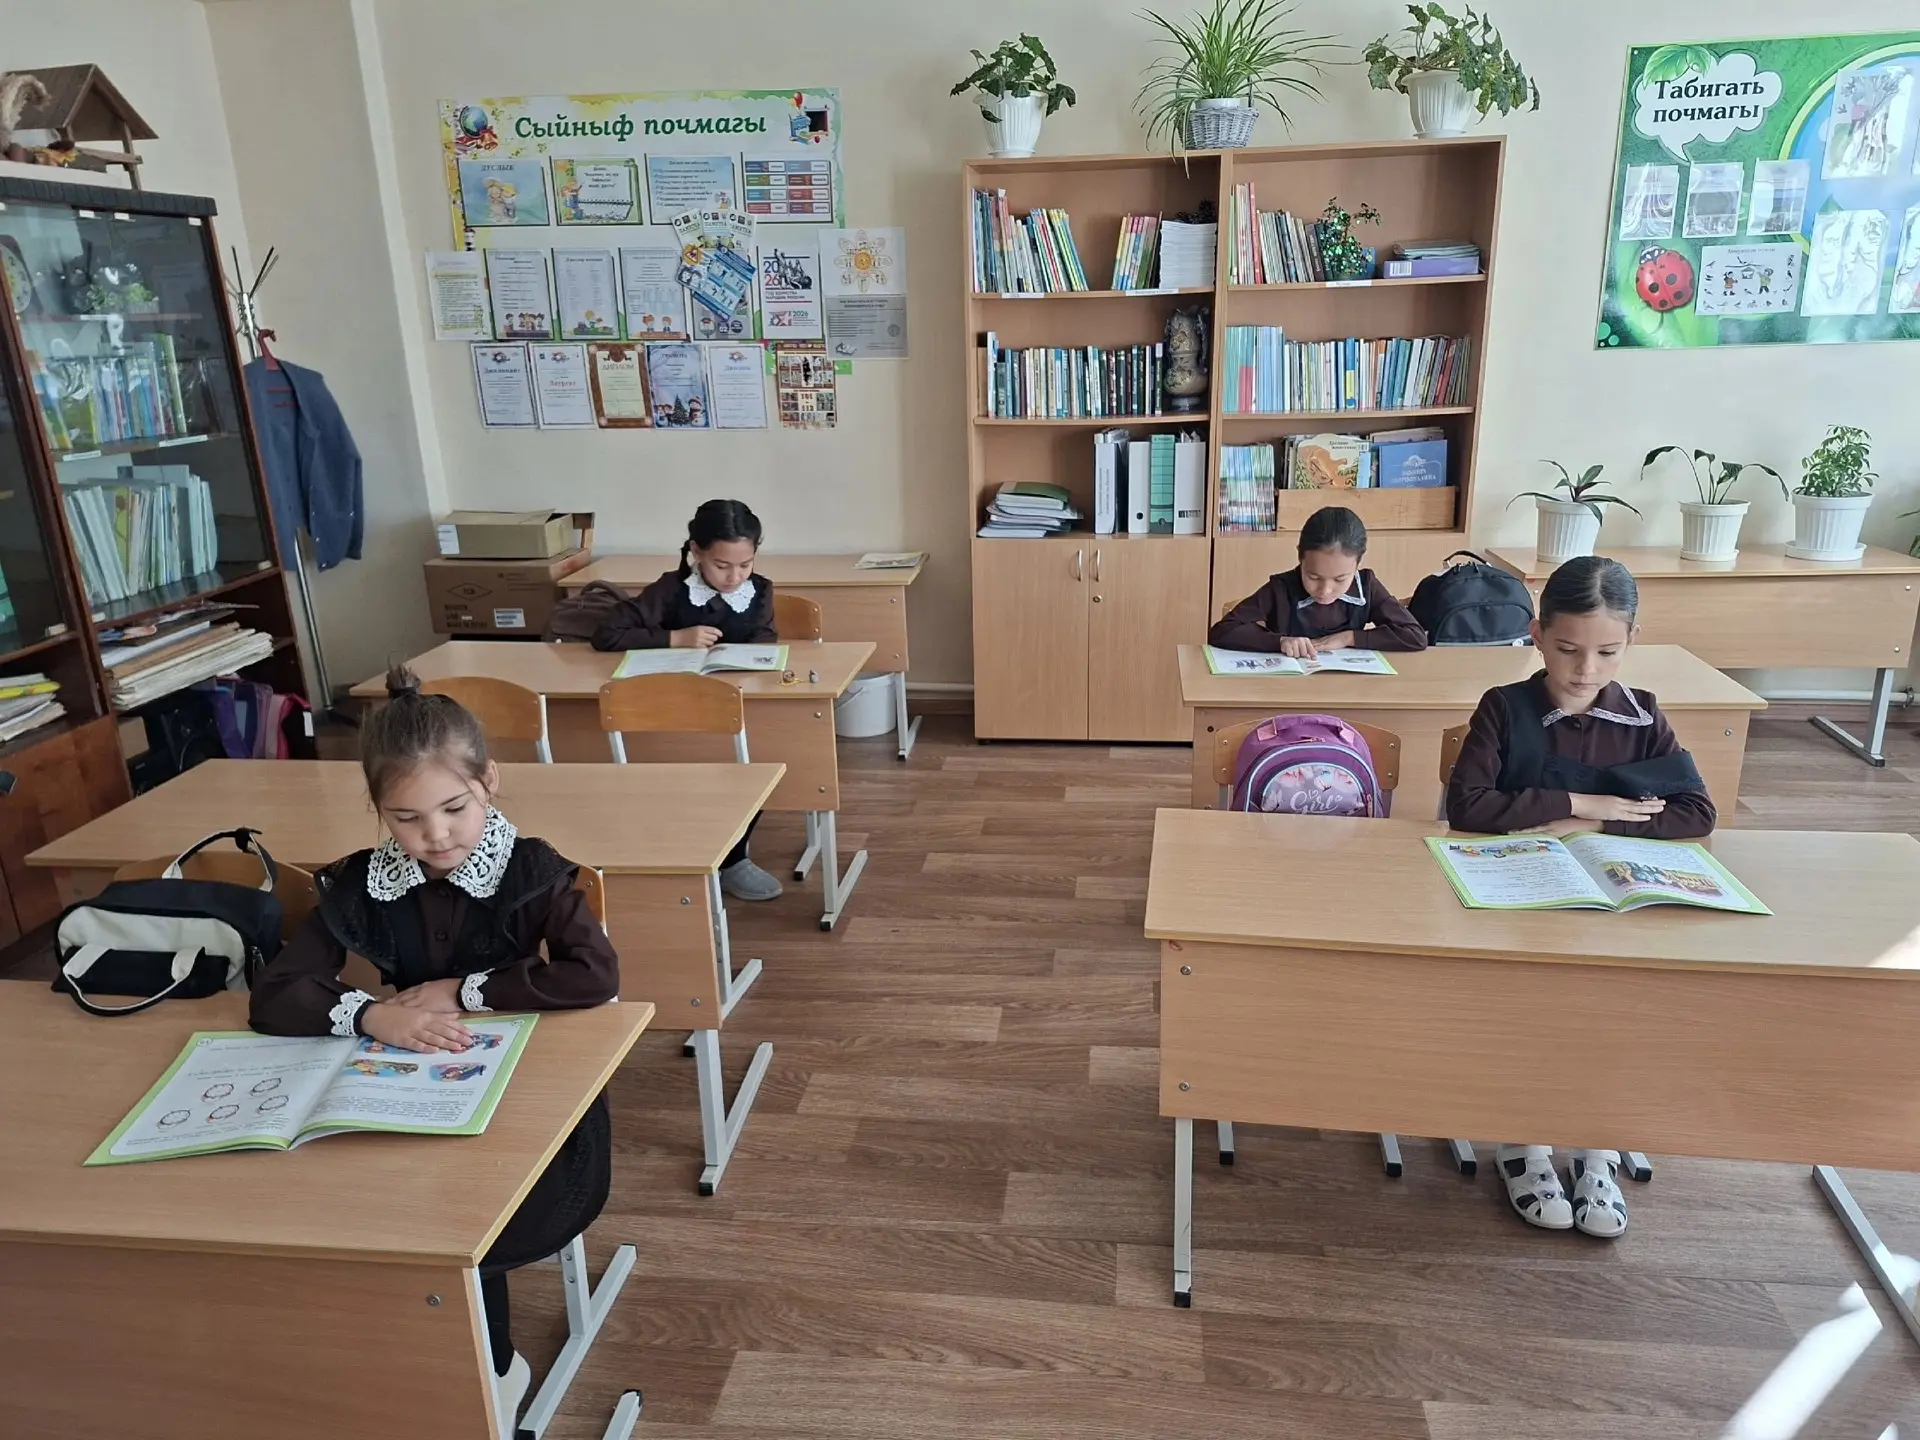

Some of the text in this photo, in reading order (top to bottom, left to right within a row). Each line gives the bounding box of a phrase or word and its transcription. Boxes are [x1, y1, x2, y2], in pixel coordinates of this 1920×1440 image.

[1654, 76, 1765, 100] Табигать
[1652, 104, 1760, 123] почмагы
[514, 113, 767, 142] Сыйныф почмагы
[763, 260, 780, 274] 20
[764, 273, 781, 287] 26
[792, 310, 809, 318] 2026
[1289, 790, 1339, 814] Girl
